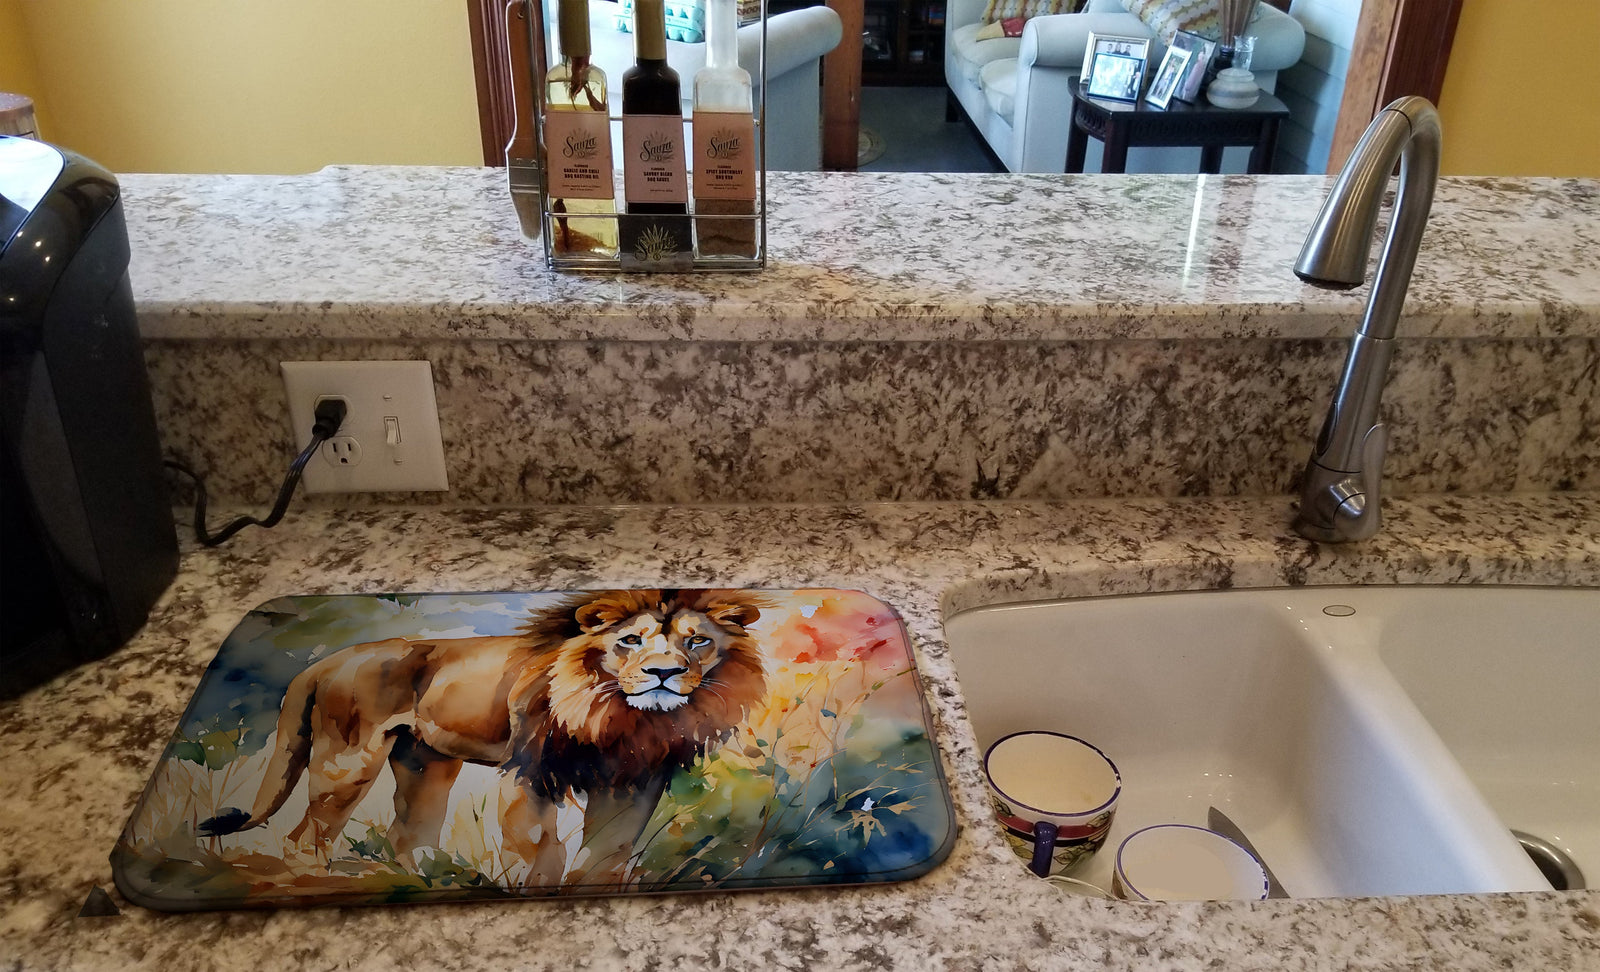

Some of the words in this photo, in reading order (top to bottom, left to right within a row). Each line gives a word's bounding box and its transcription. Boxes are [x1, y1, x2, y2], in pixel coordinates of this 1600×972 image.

[562, 136, 597, 158] Sauza
[640, 140, 673, 162] Sauza
[706, 136, 740, 159] Sauza
